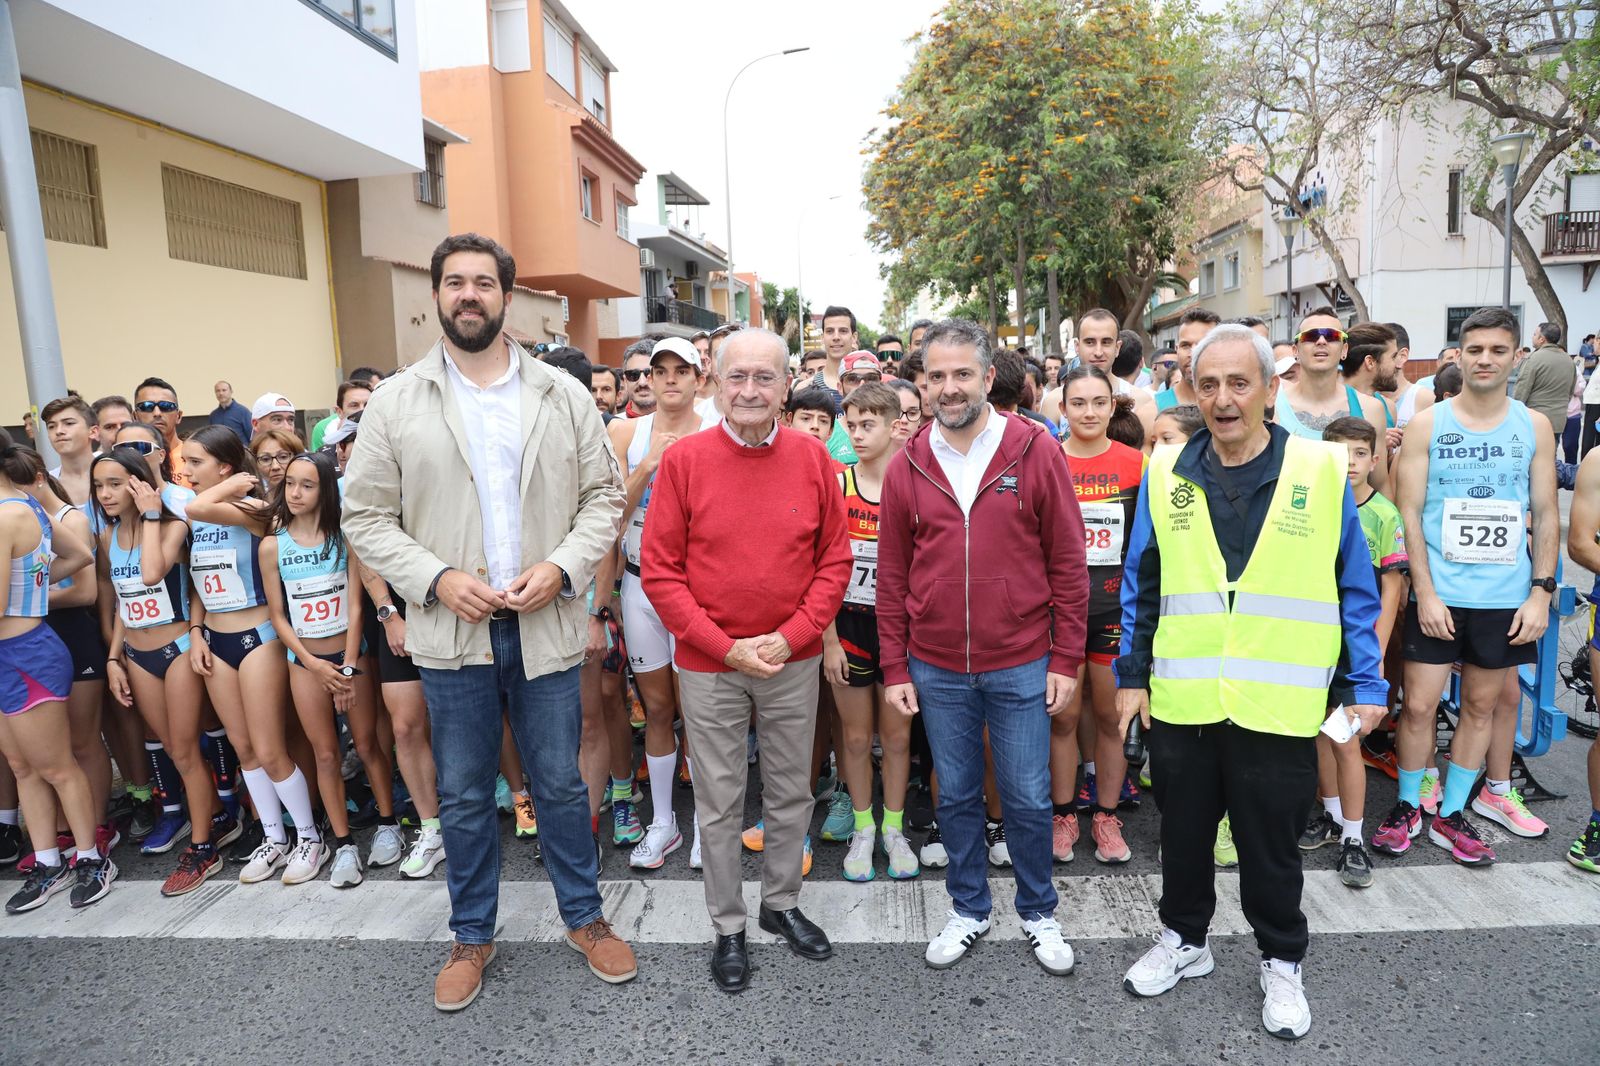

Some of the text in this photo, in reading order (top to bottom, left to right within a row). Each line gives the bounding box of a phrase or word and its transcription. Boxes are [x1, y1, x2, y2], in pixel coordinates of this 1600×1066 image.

[1438, 442, 1505, 461] nerja
[1446, 462, 1496, 470] ATLETISMO
[1072, 472, 1119, 486] álaga
[848, 508, 879, 521] Mála
[193, 528, 229, 544] nerja
[1459, 525, 1508, 548] 528
[282, 550, 331, 566] nerja
[112, 563, 140, 578] erja
[204, 574, 226, 594] 61
[301, 596, 341, 622] 297
